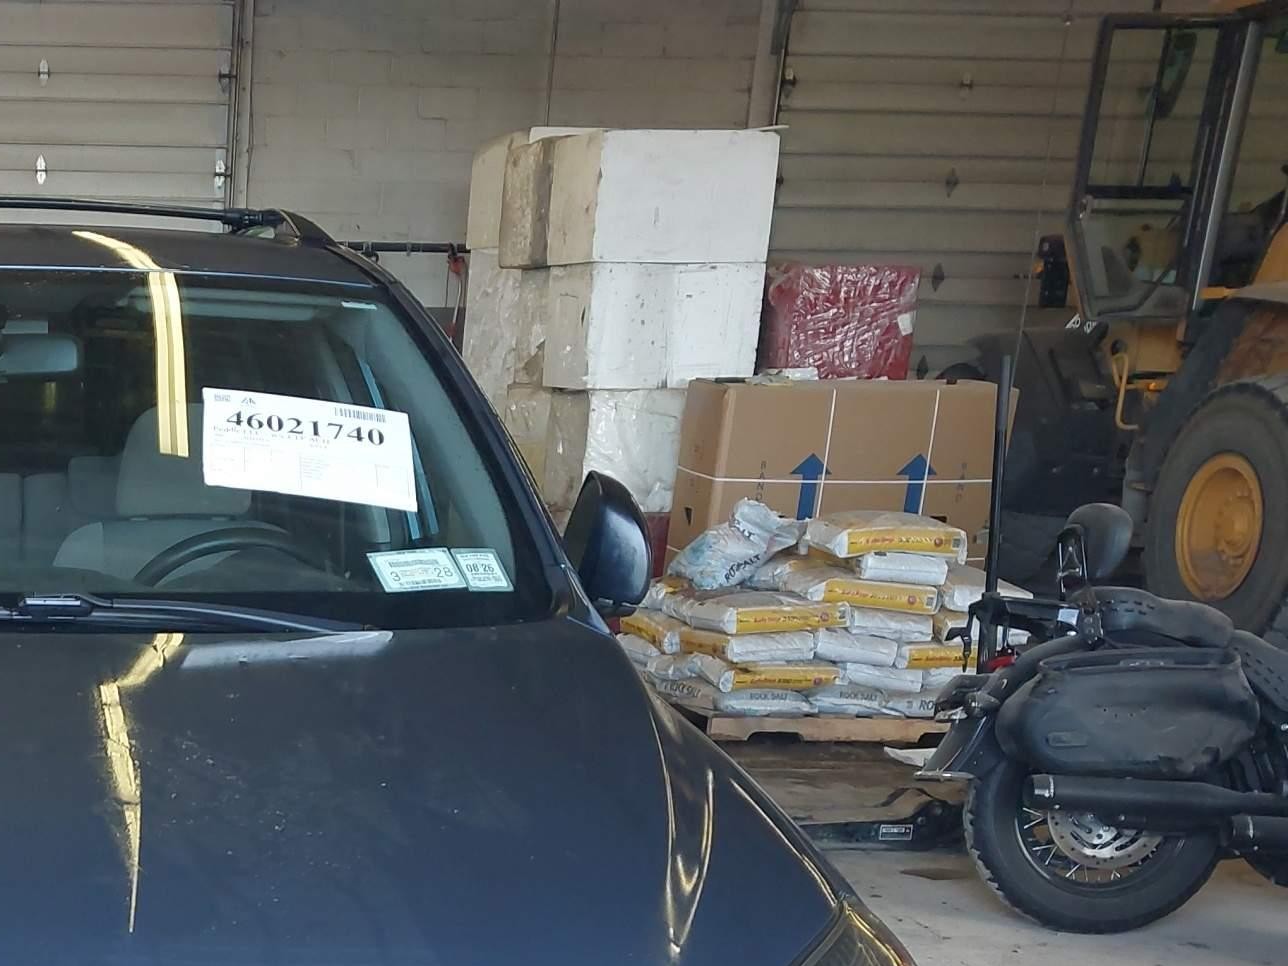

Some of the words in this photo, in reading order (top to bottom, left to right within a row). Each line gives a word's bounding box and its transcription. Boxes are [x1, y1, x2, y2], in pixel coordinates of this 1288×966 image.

[226, 410, 385, 446] 46021740
[390, 571, 401, 582] 3
[434, 567, 454, 578] 28
